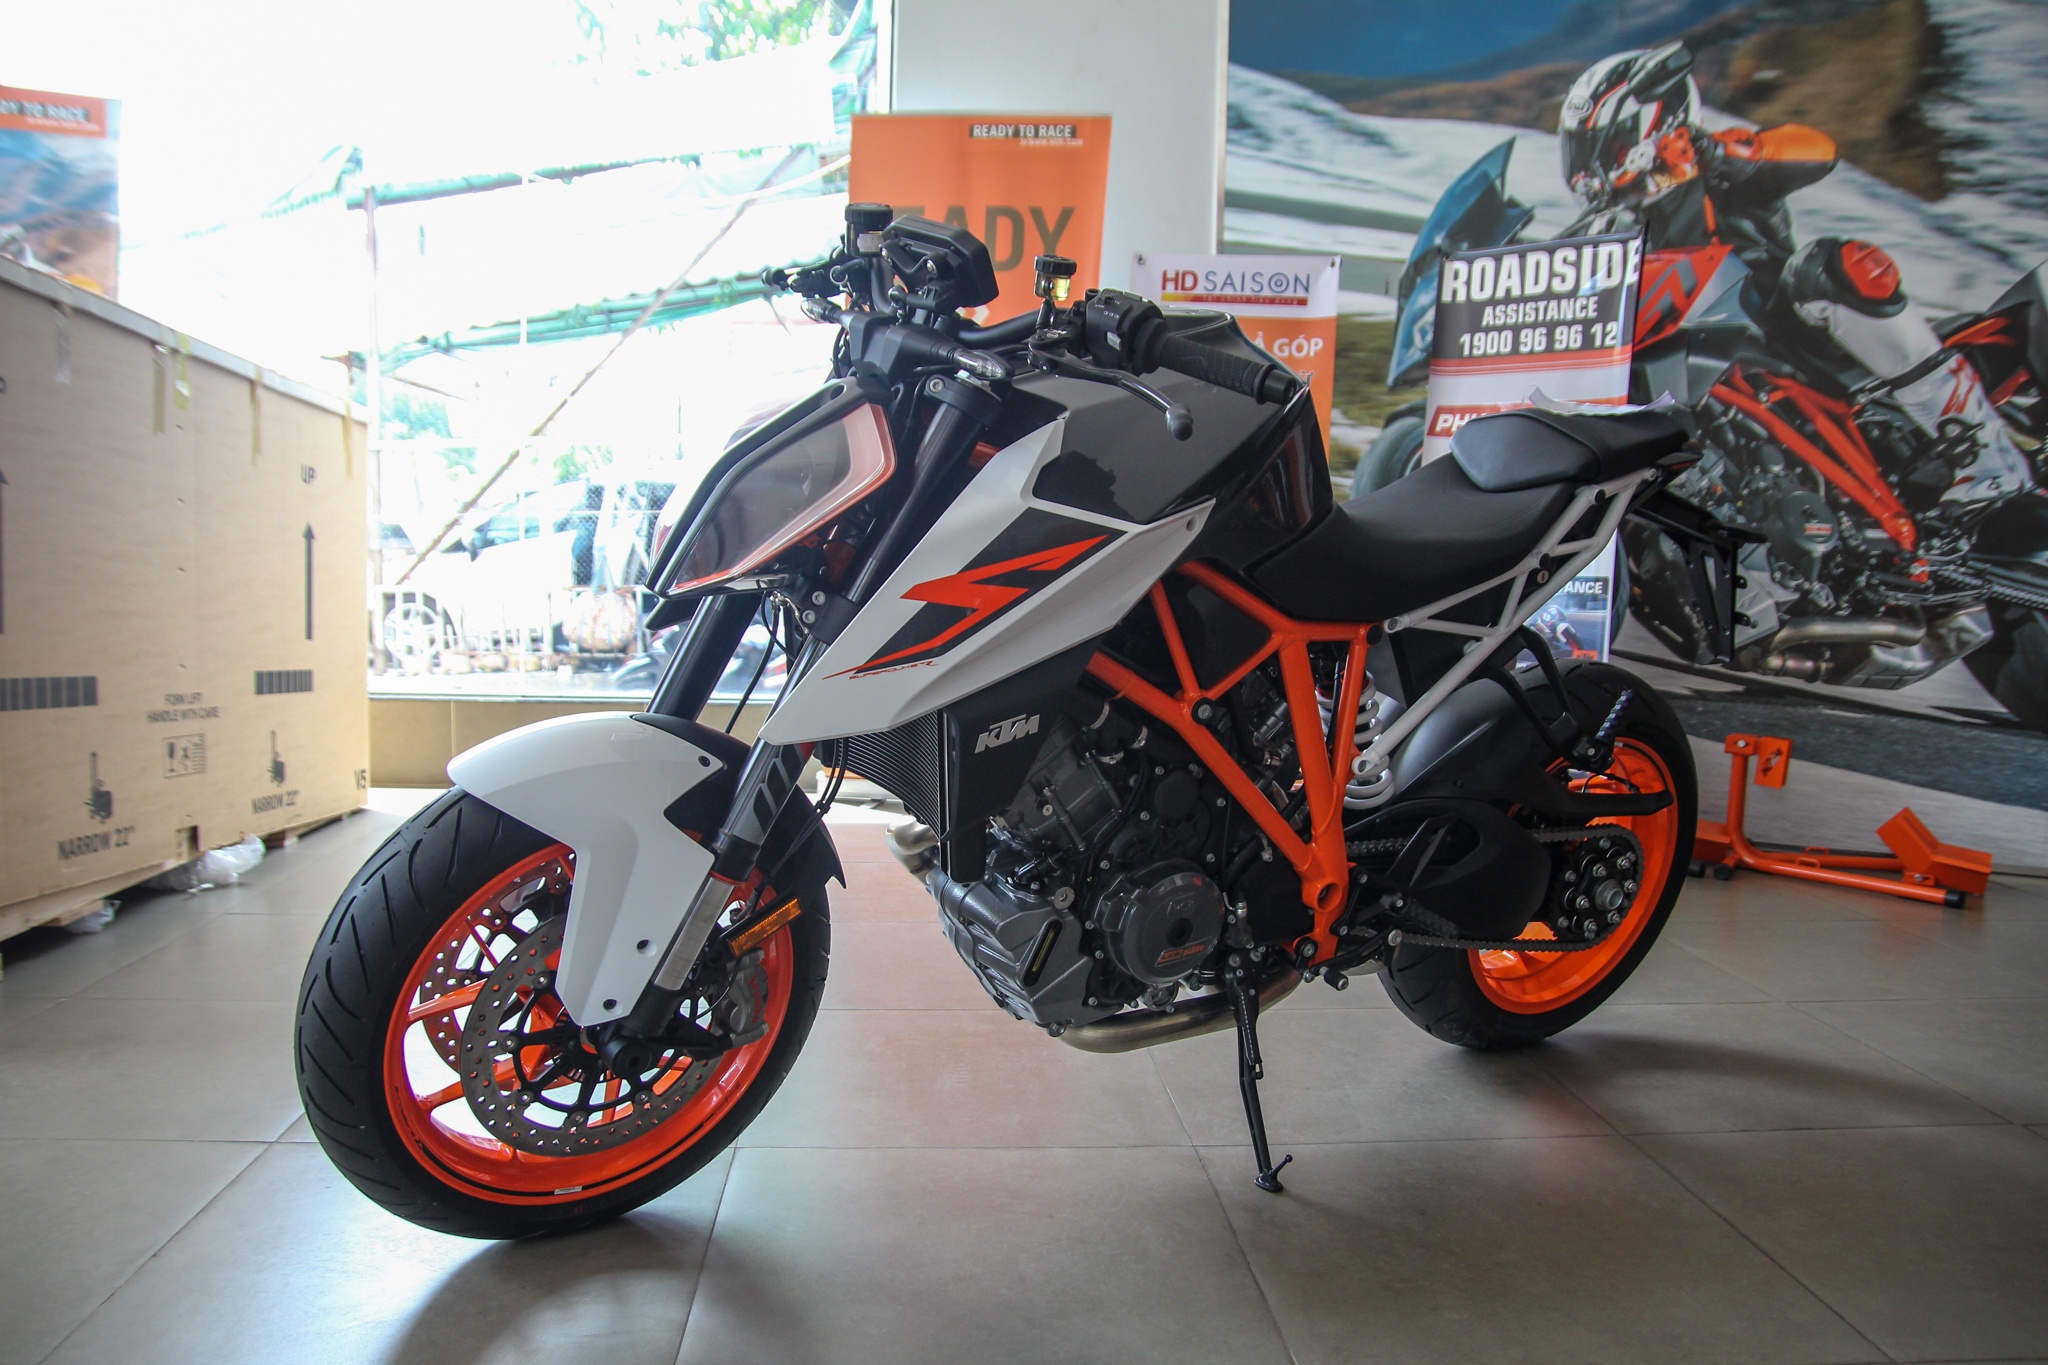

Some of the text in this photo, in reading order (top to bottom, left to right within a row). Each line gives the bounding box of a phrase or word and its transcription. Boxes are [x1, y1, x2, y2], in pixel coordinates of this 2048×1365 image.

[973, 124, 1072, 137] READY TO RACE
[1162, 269, 1311, 294] HD SAISON
[1440, 238, 1640, 304] ROADSIDE
[1482, 296, 1599, 327] ASSISTANCE
[1273, 334, 1324, 357] GÓP
[1459, 320, 1619, 357] 1900 96 96 12
[300, 463, 314, 484] UP
[1560, 581, 1604, 594] ANCE
[975, 713, 1040, 754] KTM
[251, 794, 283, 813] NARROW
[58, 832, 110, 860] NARROW
